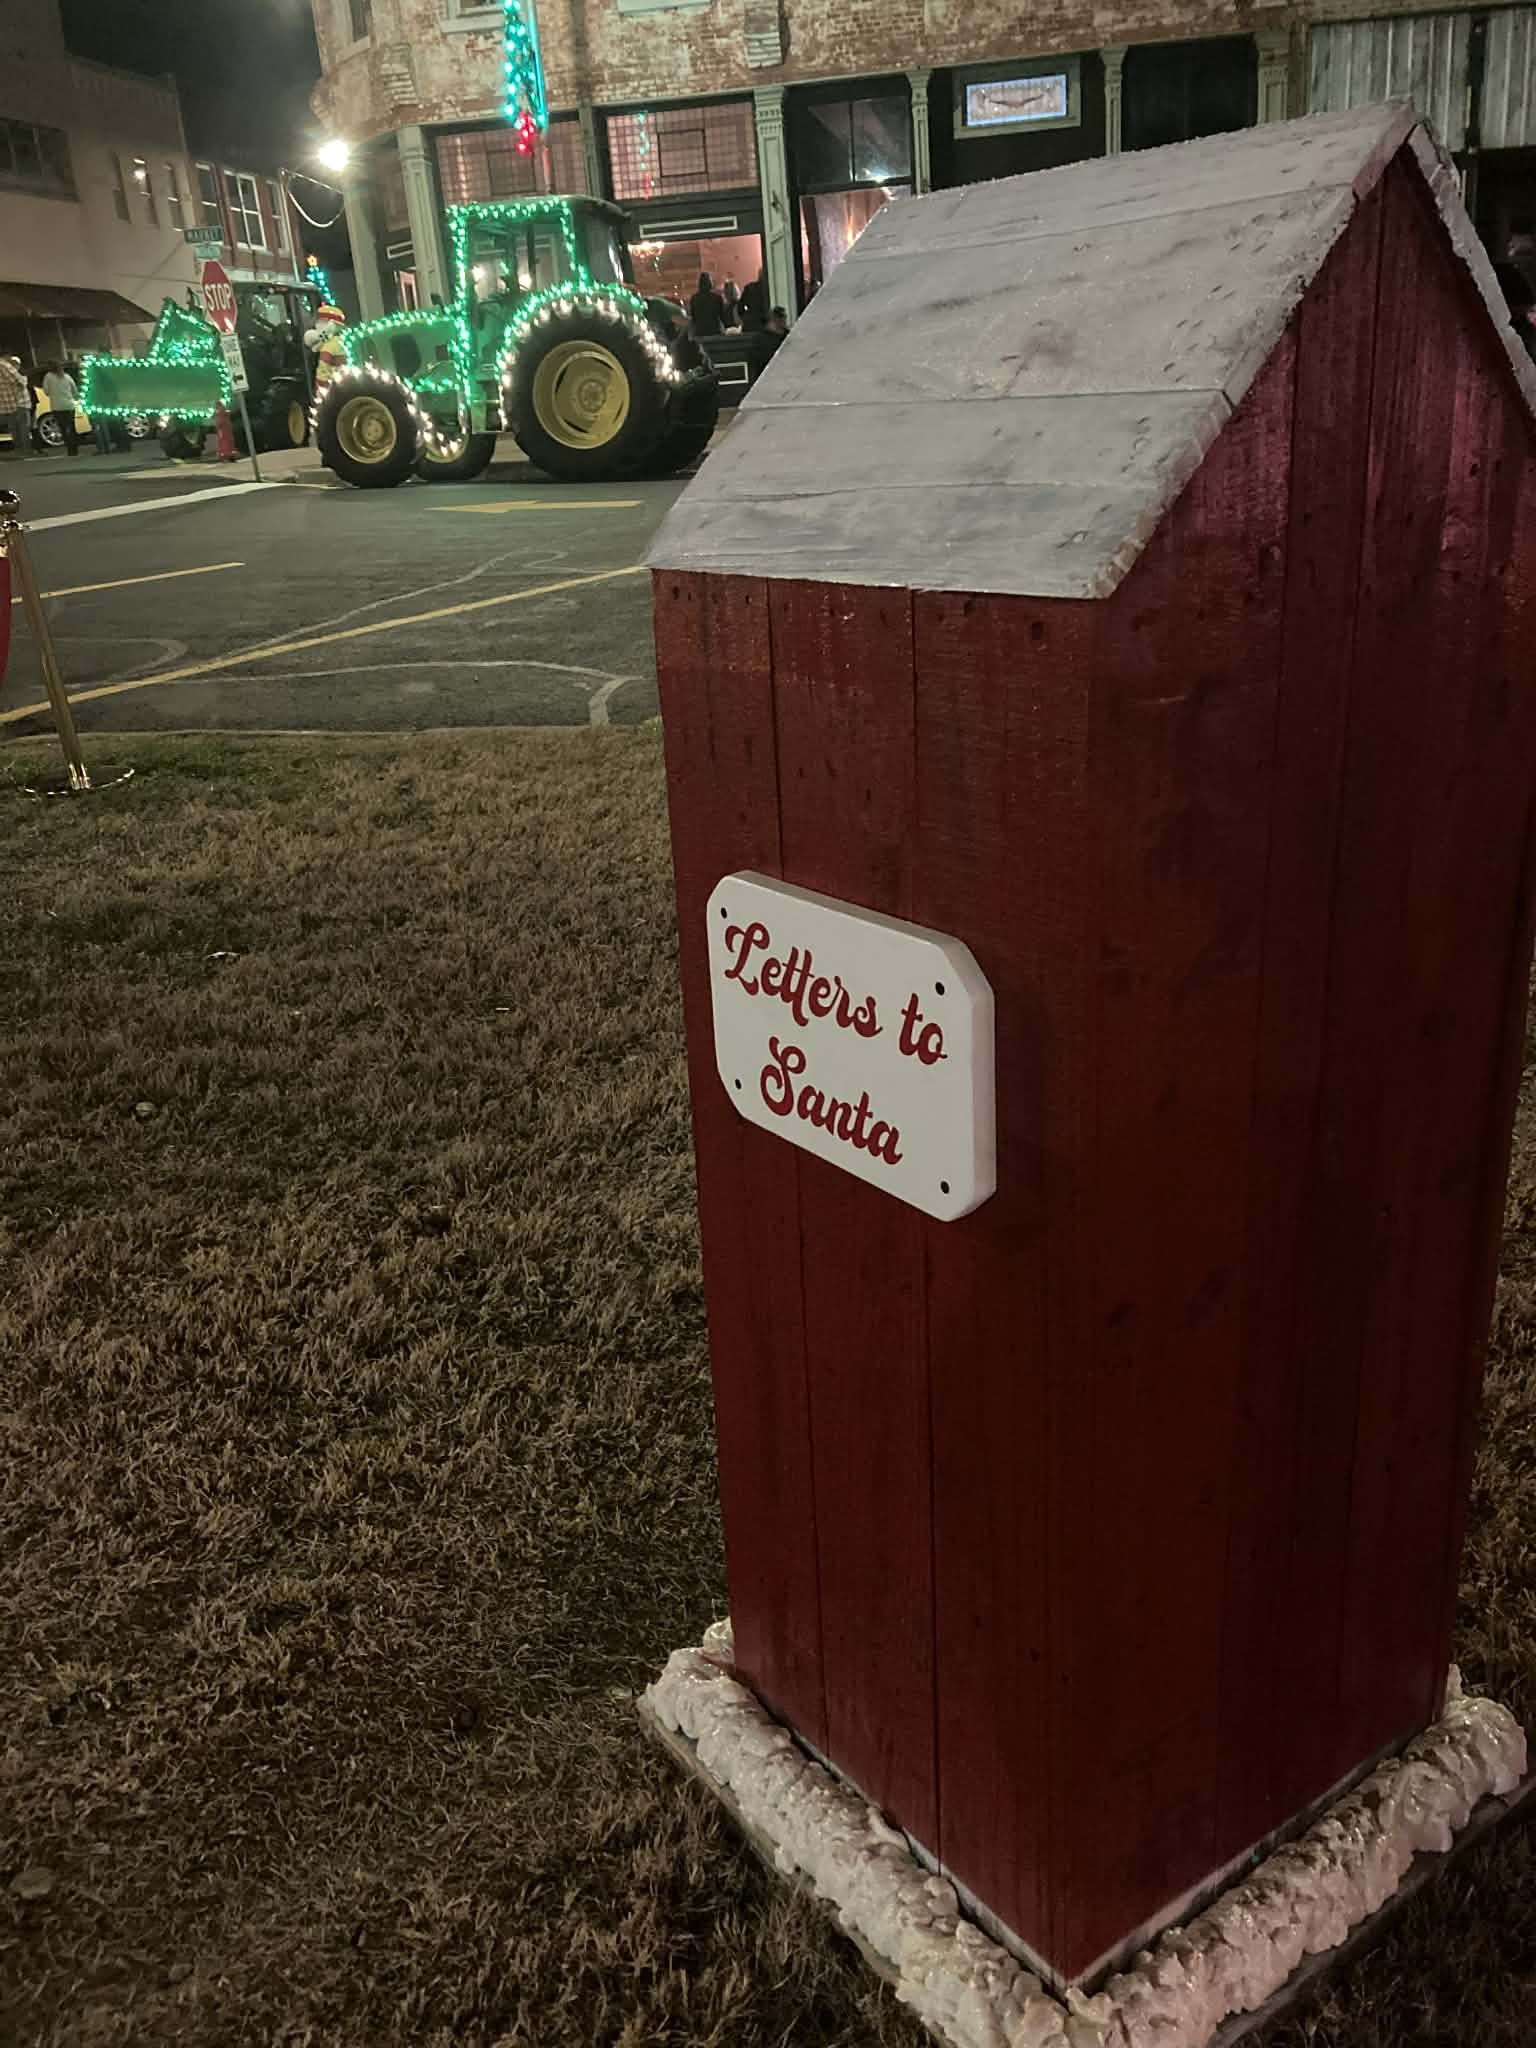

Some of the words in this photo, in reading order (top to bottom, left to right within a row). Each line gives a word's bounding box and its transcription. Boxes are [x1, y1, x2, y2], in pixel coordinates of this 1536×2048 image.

[204, 283, 231, 311] STOP
[724, 922, 883, 1037] Letters
[899, 992, 948, 1065] to
[760, 1036, 903, 1165] Santa
